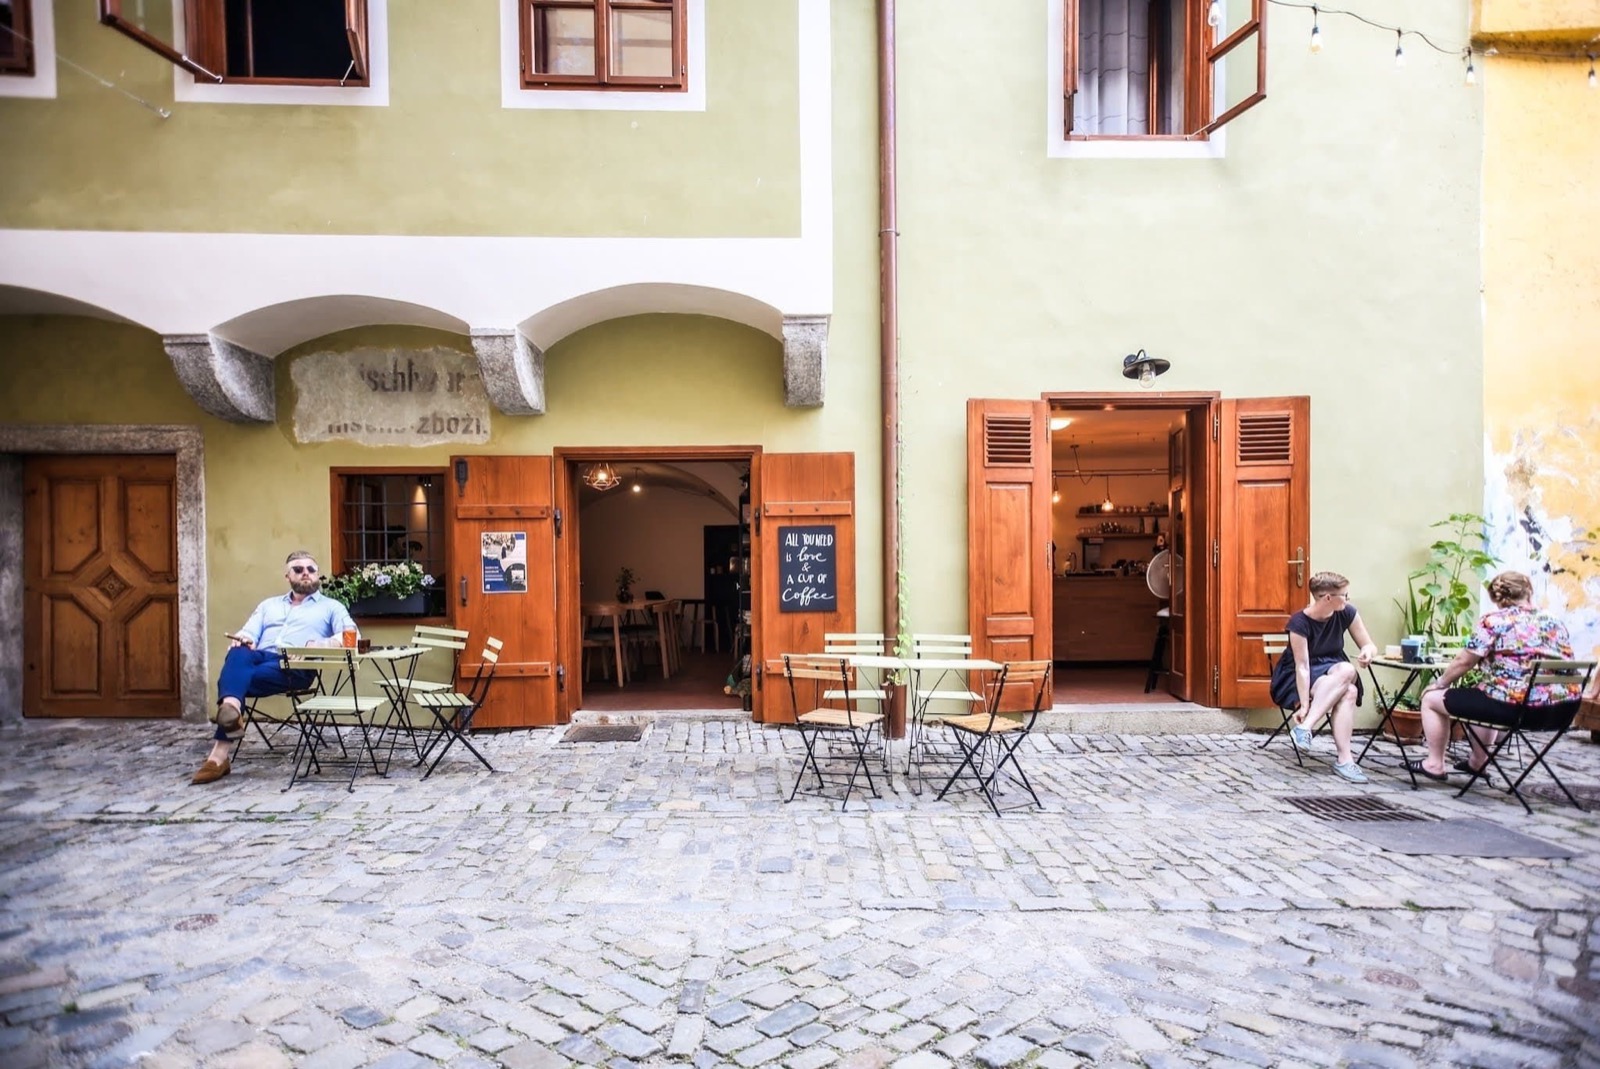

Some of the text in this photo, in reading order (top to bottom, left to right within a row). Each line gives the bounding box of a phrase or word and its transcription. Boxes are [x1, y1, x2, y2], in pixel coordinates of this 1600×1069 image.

[785, 533, 834, 547] ALL YOU NEED
[797, 546, 827, 562] love
[801, 562, 811, 572] &
[797, 573, 815, 584] CUP
[817, 573, 828, 584] OF
[782, 586, 834, 607] Coffee
